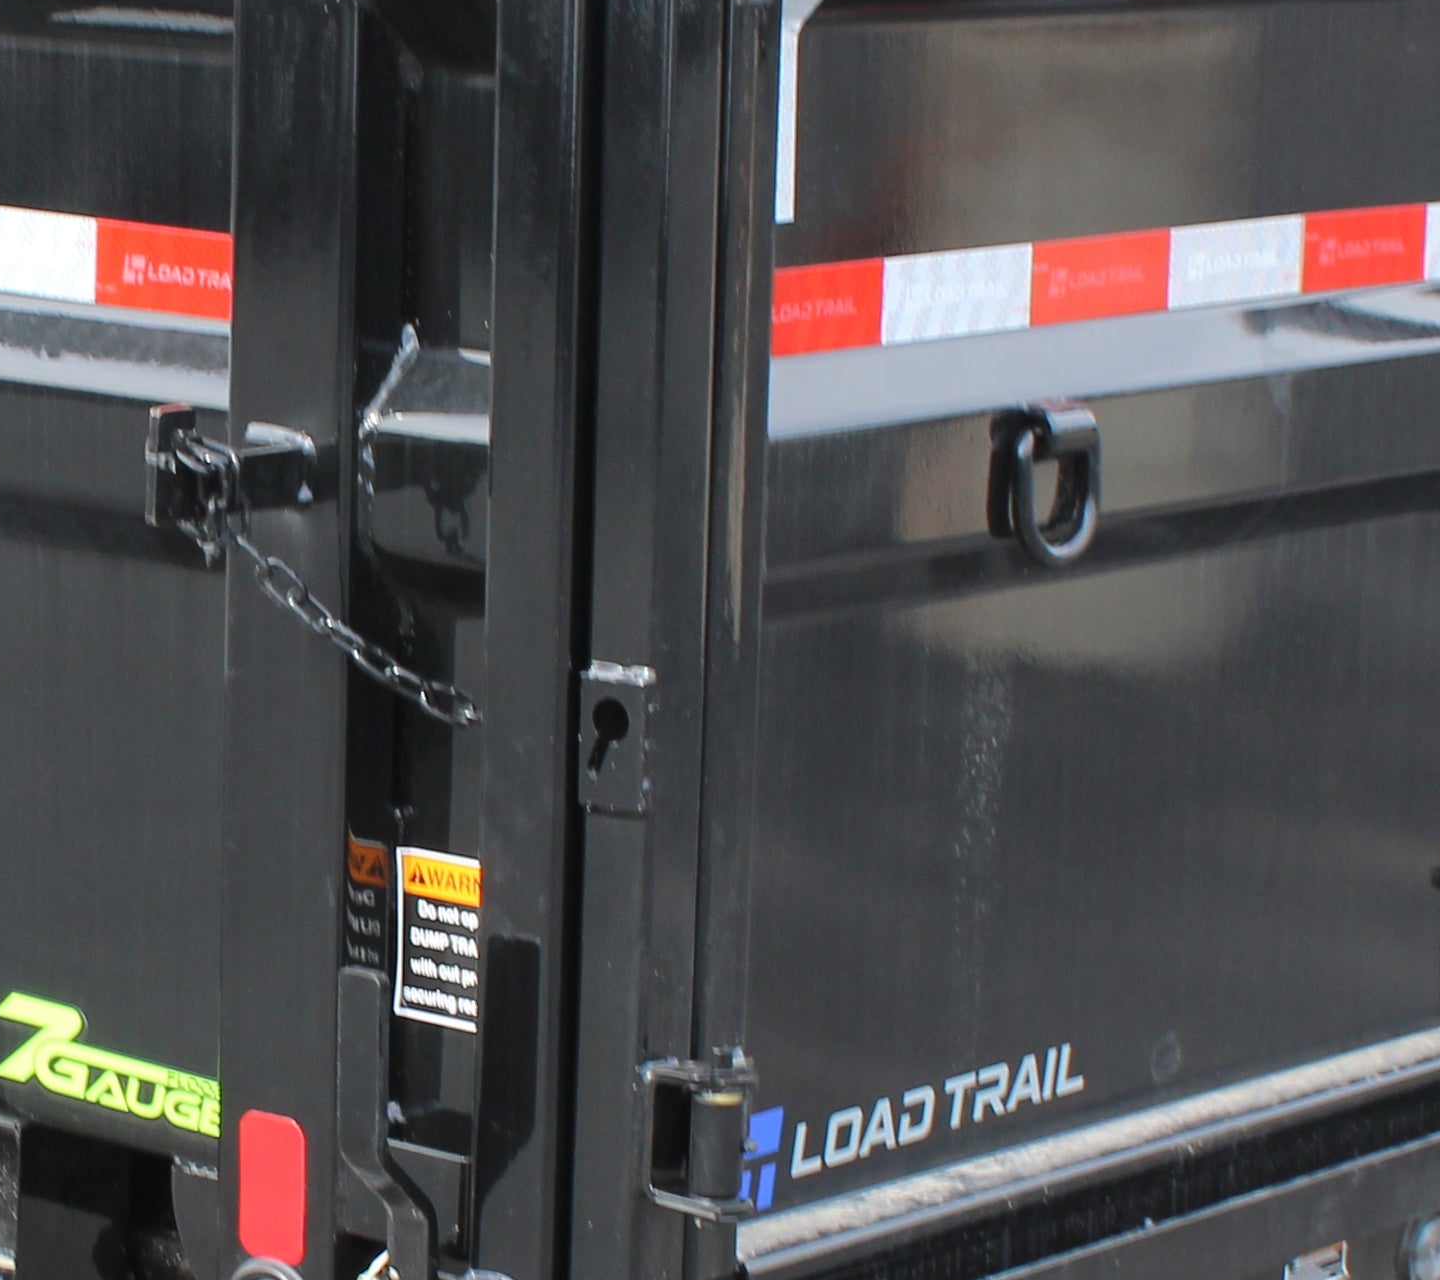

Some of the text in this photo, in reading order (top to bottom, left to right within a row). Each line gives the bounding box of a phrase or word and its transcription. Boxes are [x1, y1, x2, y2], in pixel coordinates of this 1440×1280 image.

[147, 262, 232, 291] LOAD TRA
[427, 866, 482, 896] WARN
[417, 898, 480, 933] Do not op
[410, 925, 479, 960] DUMP TRA
[409, 956, 479, 990] with out pr
[403, 985, 458, 1016] securing
[34, 1040, 221, 1139] GAUGE
[168, 1070, 221, 1101] FLOO
[790, 1042, 1085, 1180] LOAD TRAIL
